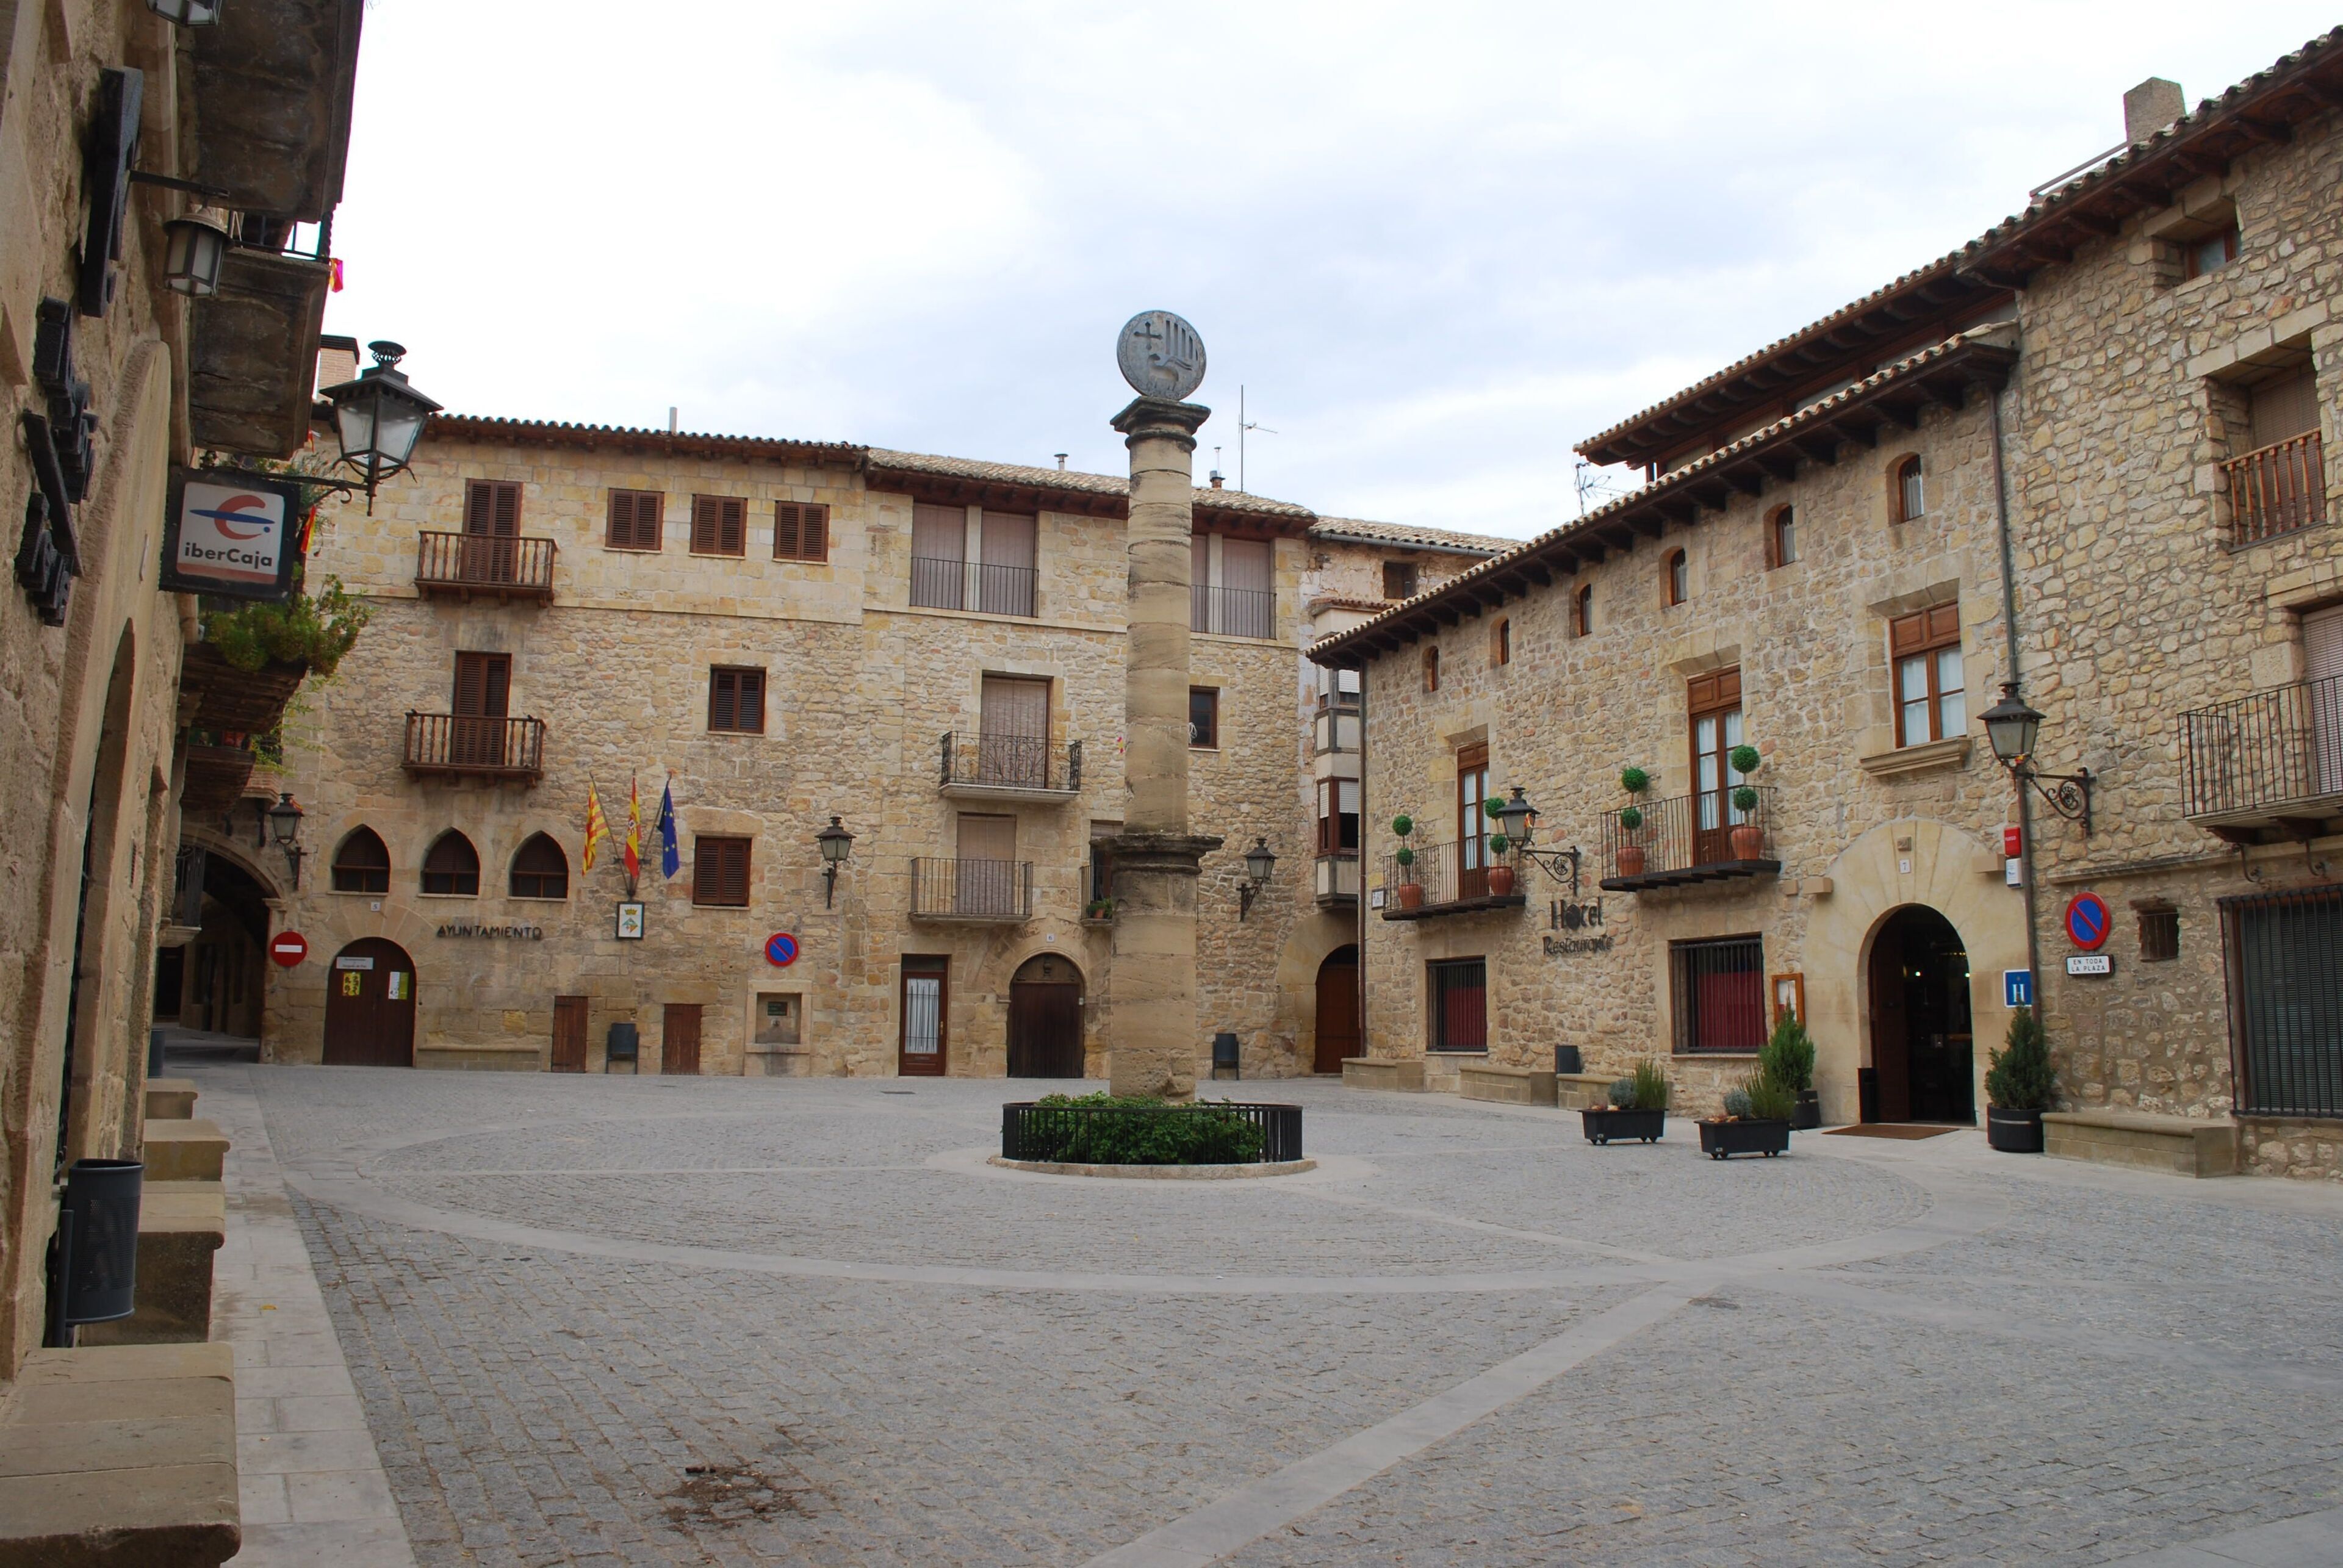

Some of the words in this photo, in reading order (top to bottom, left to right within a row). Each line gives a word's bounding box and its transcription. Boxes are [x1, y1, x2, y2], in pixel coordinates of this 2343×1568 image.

[185, 542, 273, 569] iberCaja
[1550, 896, 1603, 930] Hotel
[436, 925, 542, 940] AYUNTAMIENTO
[1542, 935, 1613, 955] Restaurante
[2012, 984, 2024, 1002] H
